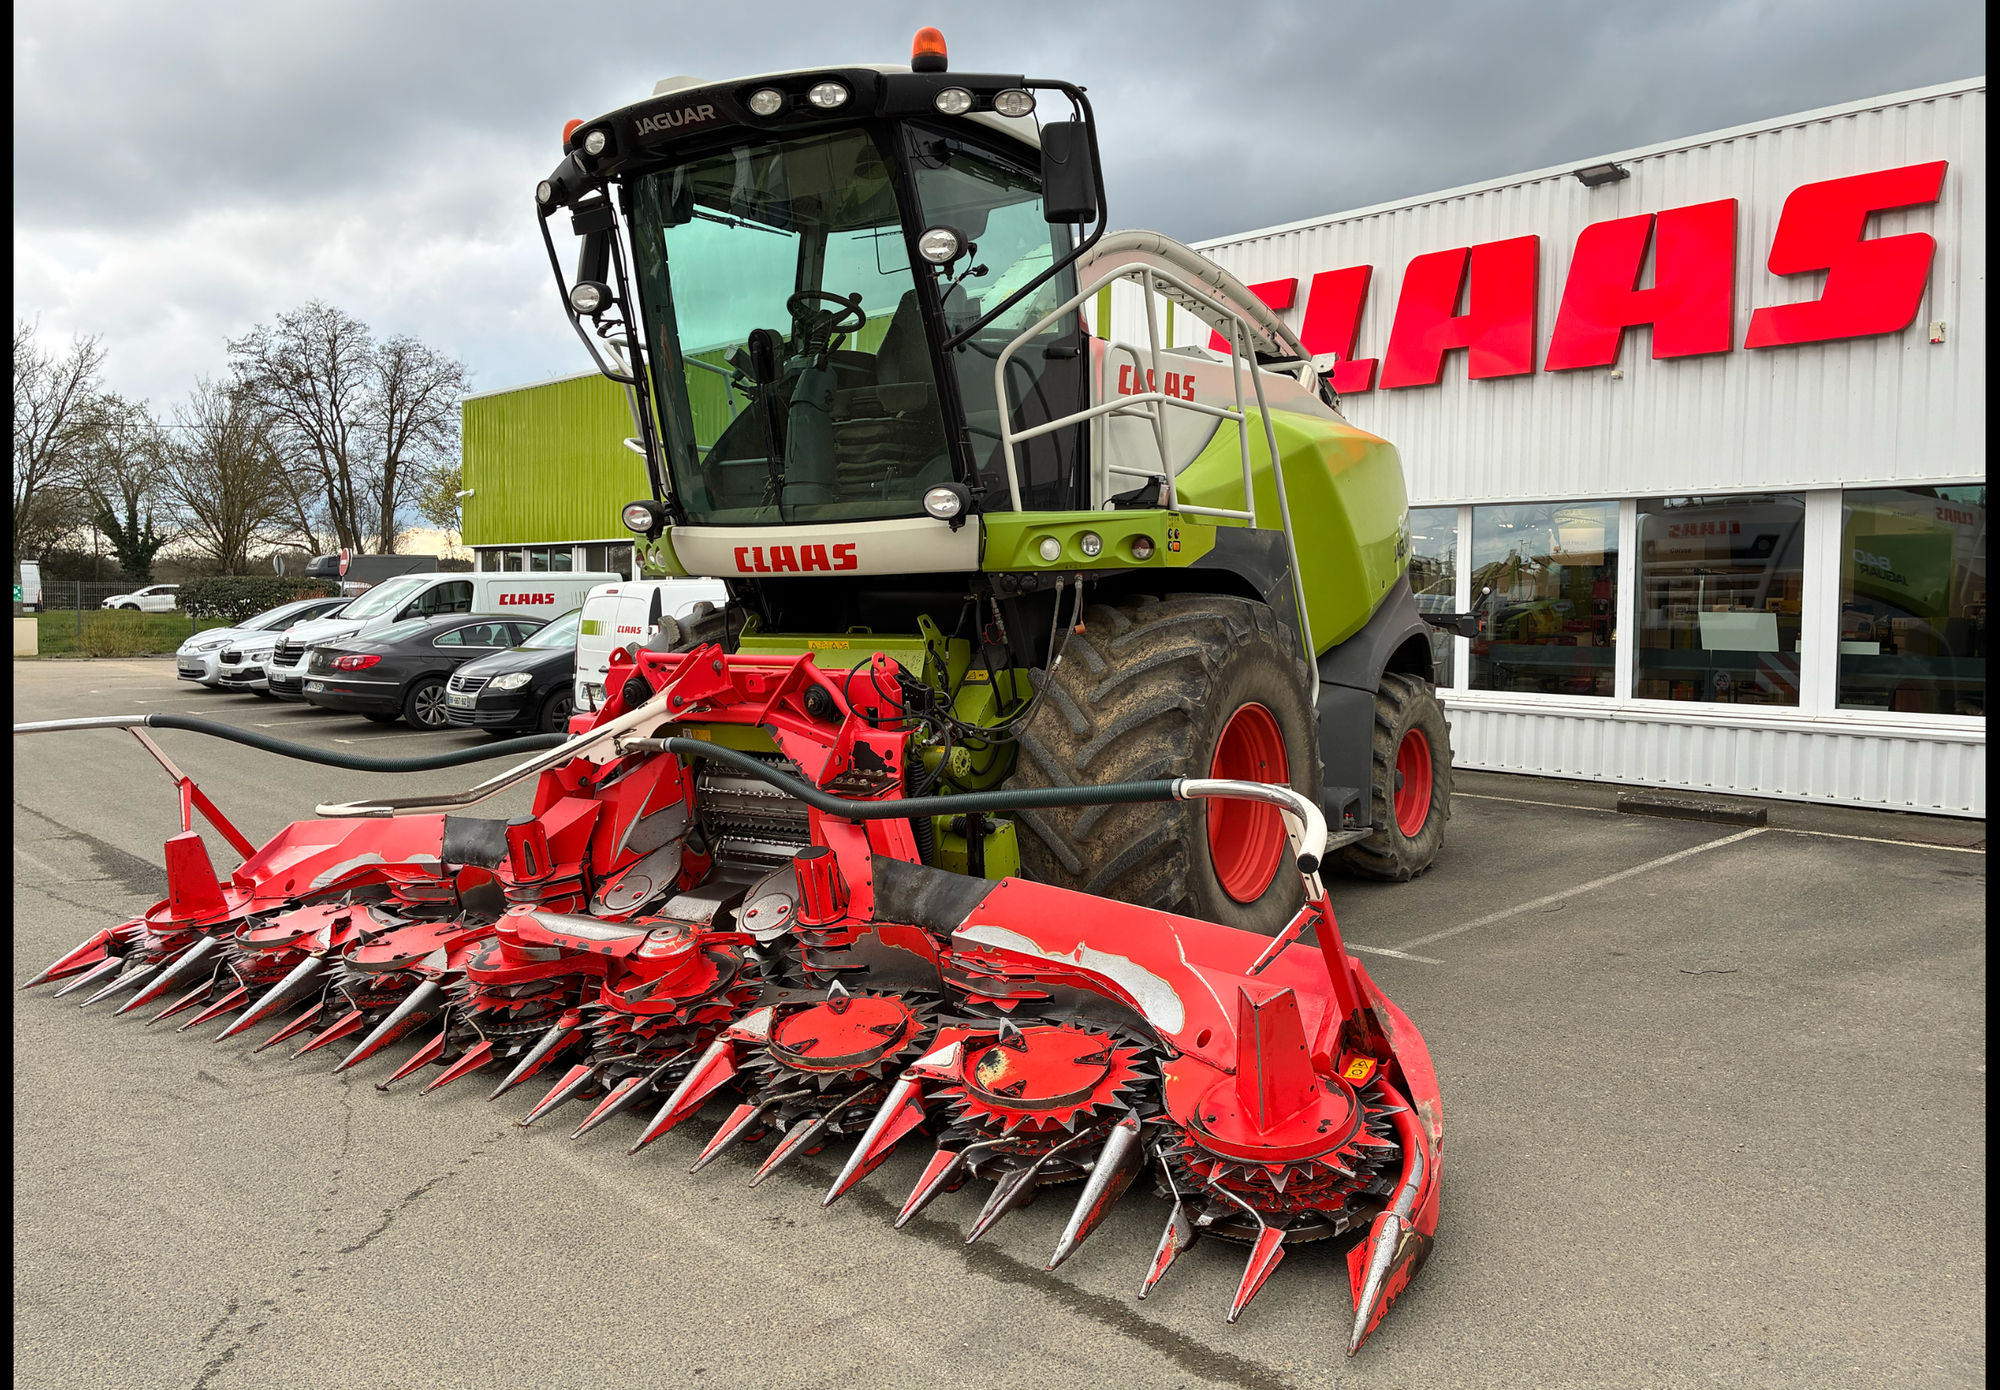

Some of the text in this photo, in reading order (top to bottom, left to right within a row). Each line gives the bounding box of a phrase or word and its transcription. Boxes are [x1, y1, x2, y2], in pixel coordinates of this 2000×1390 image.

[635, 104, 716, 136] JAGUAR
[733, 543, 858, 573] CLAAS
[499, 593, 555, 606] CLAAS
[617, 625, 642, 635] CLAAS
